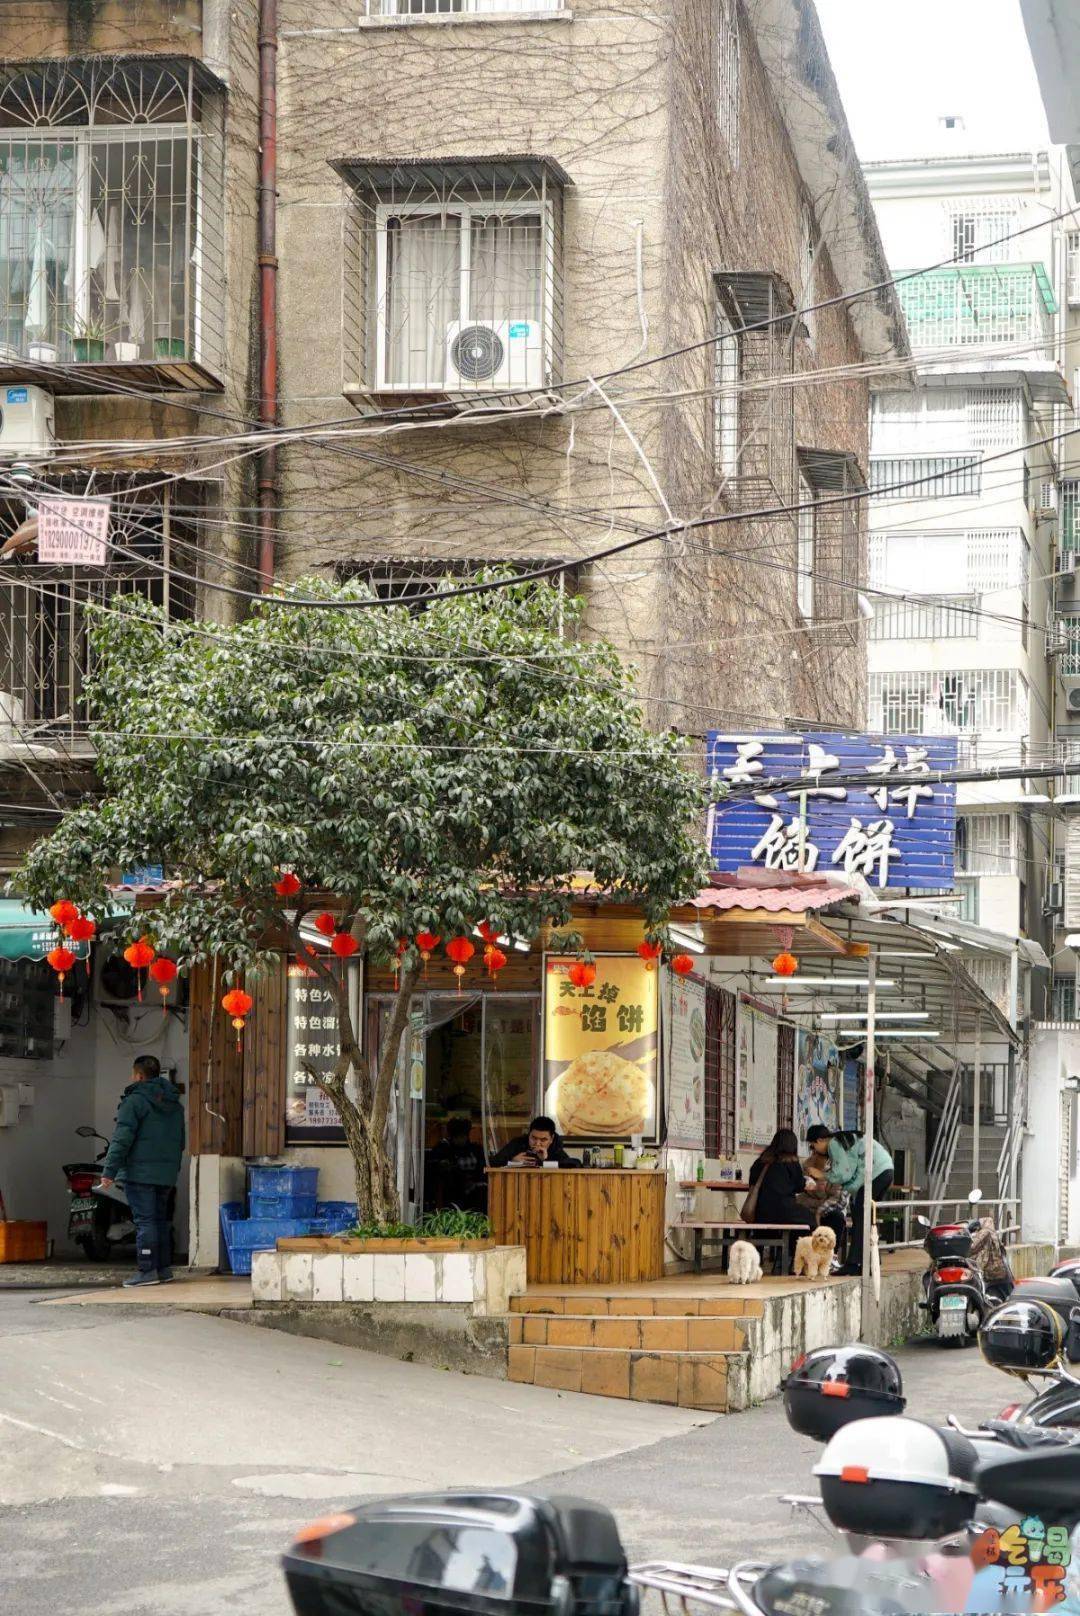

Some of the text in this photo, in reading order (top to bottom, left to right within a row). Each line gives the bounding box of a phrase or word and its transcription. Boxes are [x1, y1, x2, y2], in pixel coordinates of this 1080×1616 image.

[294, 987, 334, 1003] 特色火
[559, 981, 621, 1004] 天上掉
[294, 1015, 340, 1030] 特色溜
[581, 1004, 644, 1033] 馅饼
[293, 1043, 341, 1057] 各种水
